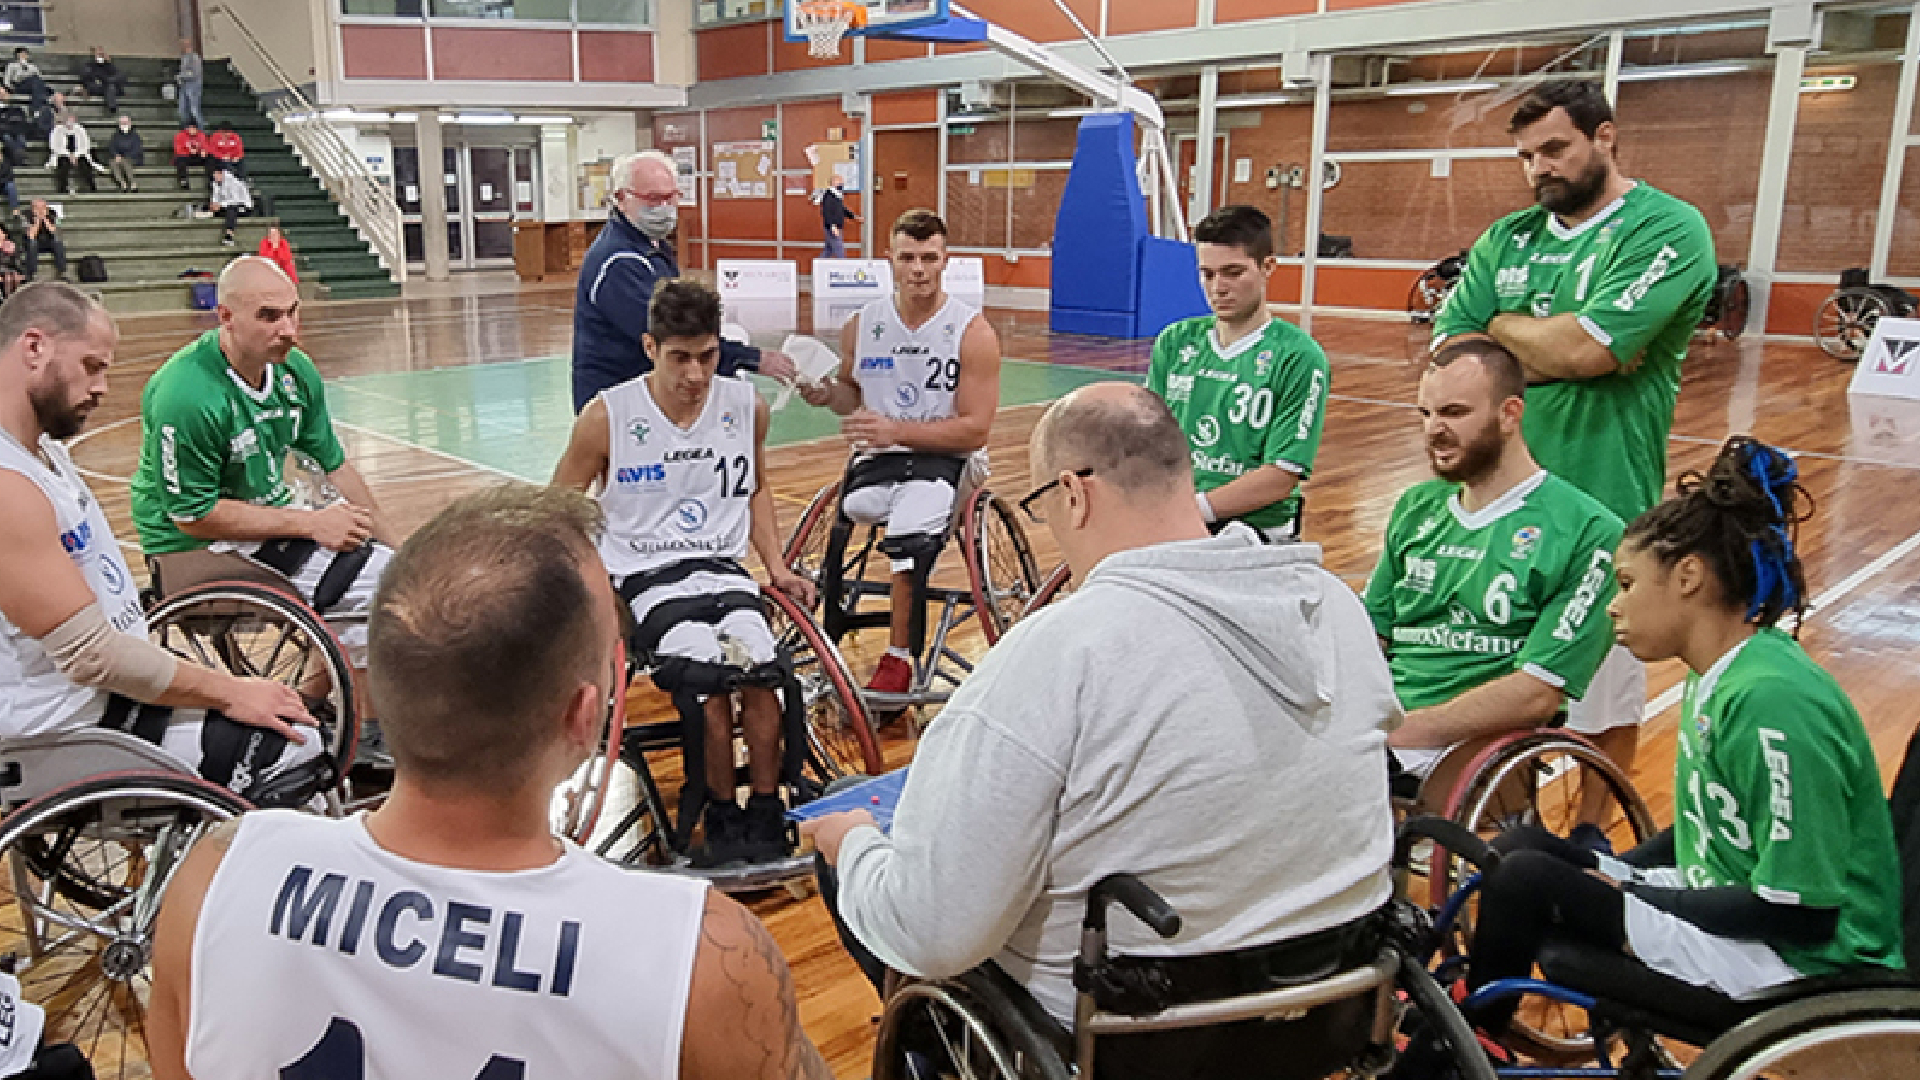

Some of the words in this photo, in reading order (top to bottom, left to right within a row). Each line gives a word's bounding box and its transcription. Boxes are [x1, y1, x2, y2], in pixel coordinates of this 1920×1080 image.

[1574, 252, 1597, 301] 1
[1613, 243, 1678, 310] LEGEA
[925, 357, 960, 391] 29
[289, 407, 303, 441] 7
[1228, 382, 1274, 430] 30
[1295, 369, 1325, 440] LEGEA
[664, 447, 714, 463] LEGEA
[714, 455, 749, 498] 12
[1482, 572, 1518, 625] 6
[1551, 549, 1613, 641] LEGEA
[1757, 727, 1793, 841] LEGEA
[268, 864, 581, 998] MICELI
